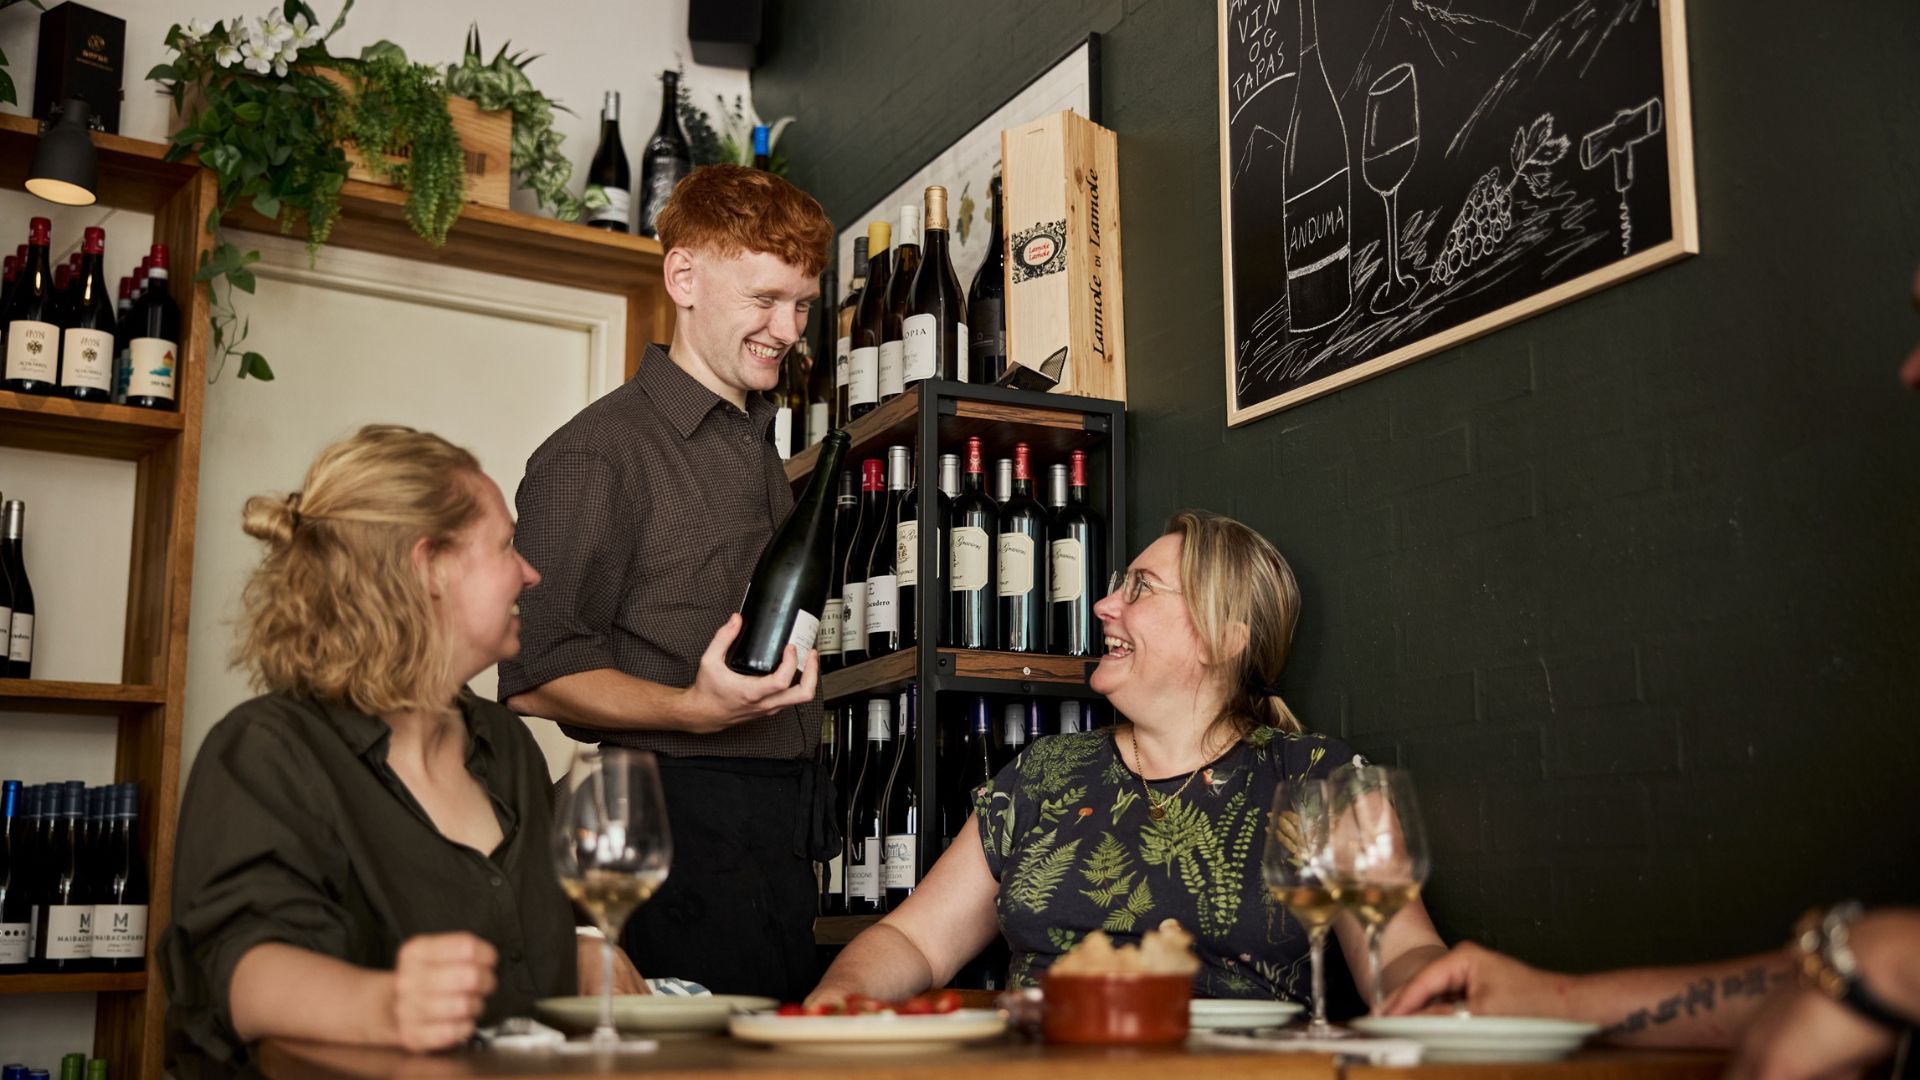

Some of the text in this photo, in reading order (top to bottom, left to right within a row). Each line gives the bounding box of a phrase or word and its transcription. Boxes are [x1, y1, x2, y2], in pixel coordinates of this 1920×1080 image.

[1238, 0, 1280, 43] VIN
[1249, 28, 1277, 62] OG
[1233, 41, 1284, 101] TAPAS
[1086, 169, 1100, 249] Lamole
[1288, 205, 1344, 260] ANDUMA
[1089, 275, 1105, 359] Lamole
